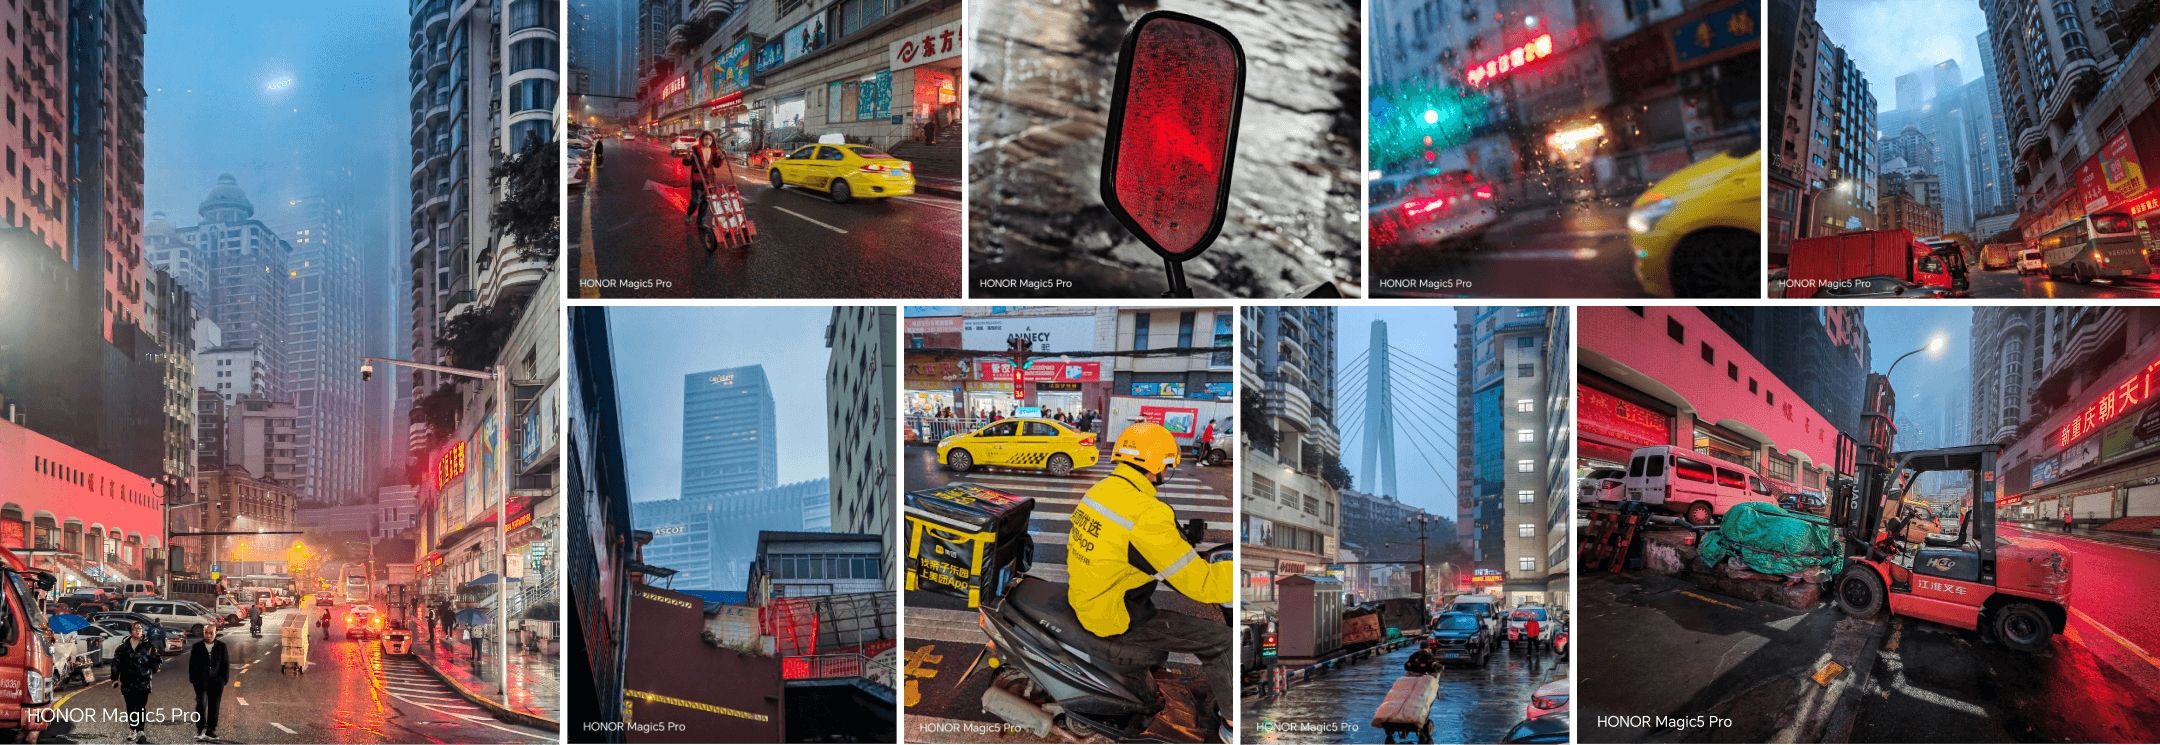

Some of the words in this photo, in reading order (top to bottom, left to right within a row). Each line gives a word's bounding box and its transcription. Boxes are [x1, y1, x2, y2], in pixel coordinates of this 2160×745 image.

[922, 24, 962, 57] 东方
[1850, 488, 1860, 510] JAC
[1917, 579, 1967, 596] 江淮叉车
